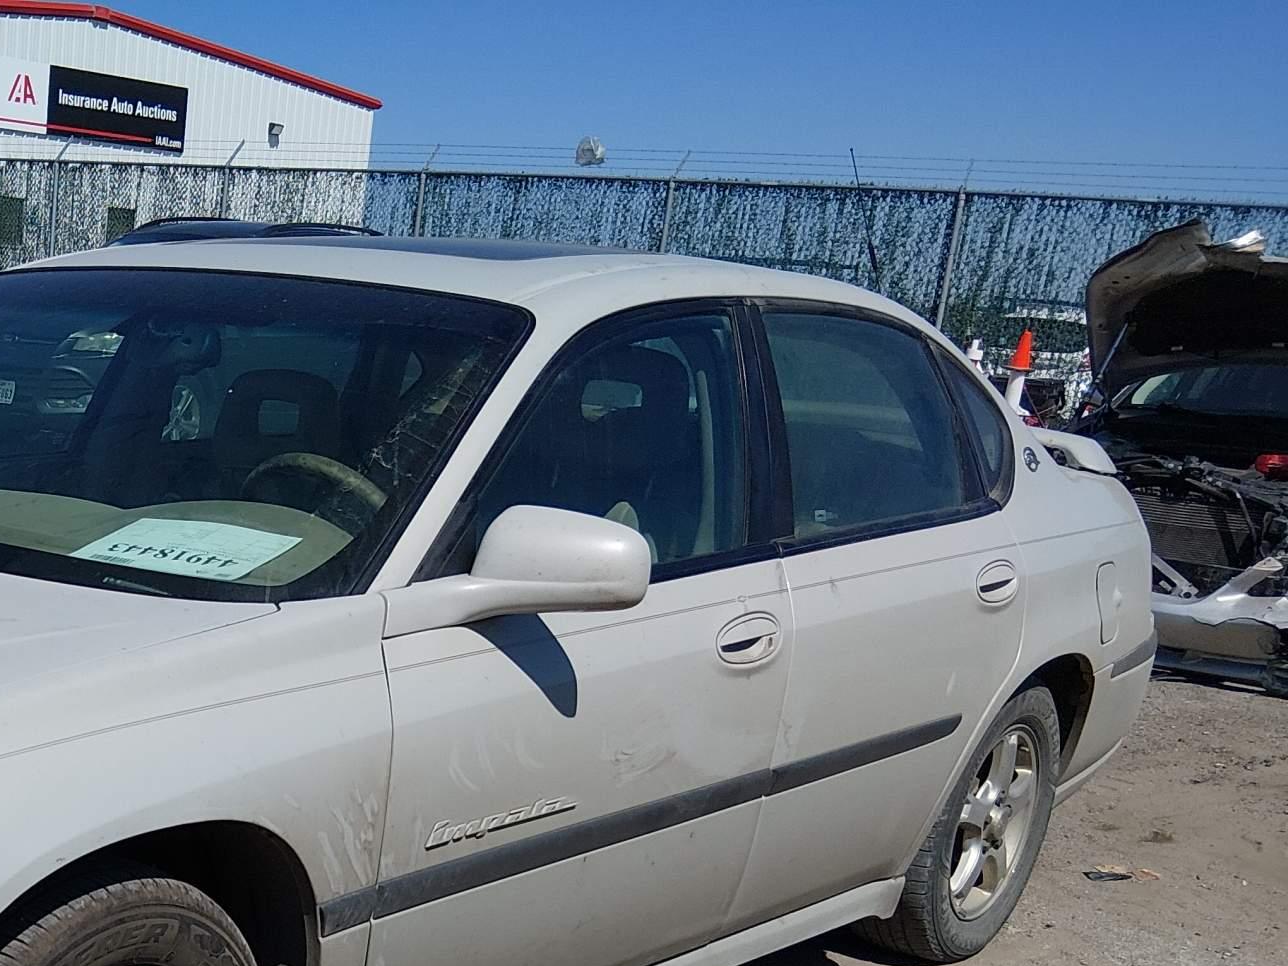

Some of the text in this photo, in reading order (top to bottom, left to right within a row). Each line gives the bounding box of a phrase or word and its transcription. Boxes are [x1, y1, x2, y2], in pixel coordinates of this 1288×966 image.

[58, 89, 177, 121] Insurance Auto Auctions
[107, 542, 239, 569] 44918443
[424, 795, 578, 851] Impala
